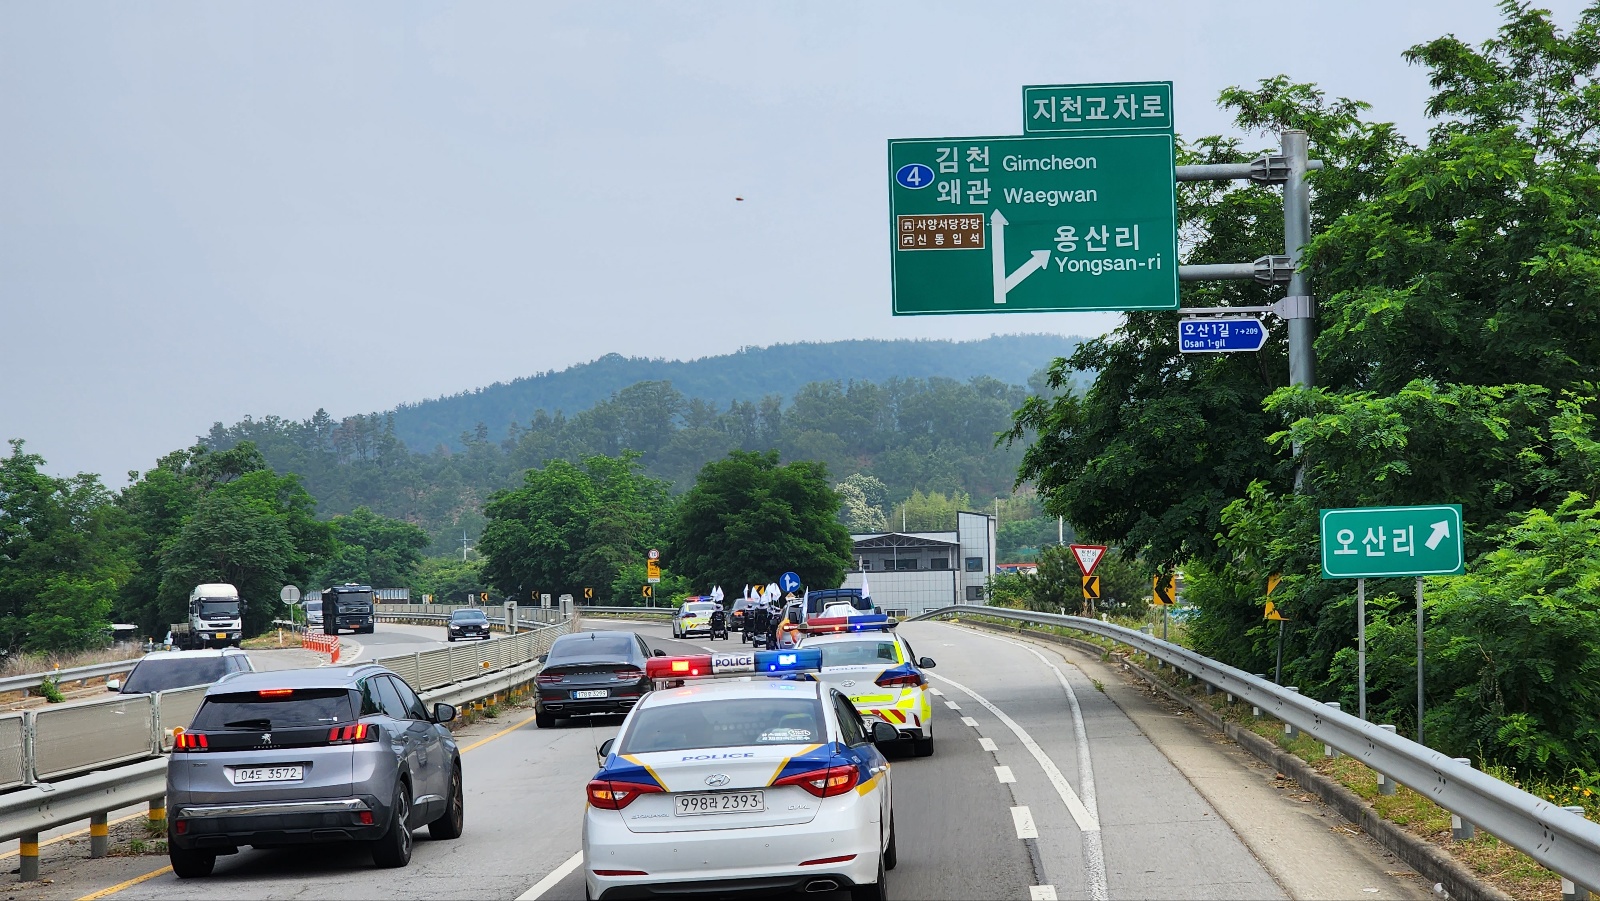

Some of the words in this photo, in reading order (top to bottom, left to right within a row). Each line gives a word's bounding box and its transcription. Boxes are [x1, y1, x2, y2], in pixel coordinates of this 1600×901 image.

[1032, 93, 1165, 123] 지천교차로
[935, 145, 991, 174] 김천
[1002, 154, 1097, 172] Gimcheon
[906, 167, 921, 186] 4
[936, 178, 991, 205] 왜관
[1003, 187, 1098, 207] Waegwan
[916, 218, 980, 231] 사양서당강당
[1054, 224, 1140, 253] 용산리
[1056, 253, 1160, 276] Yongsan-ri
[1184, 323, 1229, 338] 오산1길
[1184, 339, 1204, 348] Osan
[1207, 339, 1226, 349] 1-gil
[1334, 525, 1414, 557] 오산리
[715, 657, 752, 667] POLICE
[681, 752, 755, 763] POLICE
[268, 767, 296, 779] 3572
[681, 797, 720, 814] 998라
[724, 794, 759, 811] 2393
